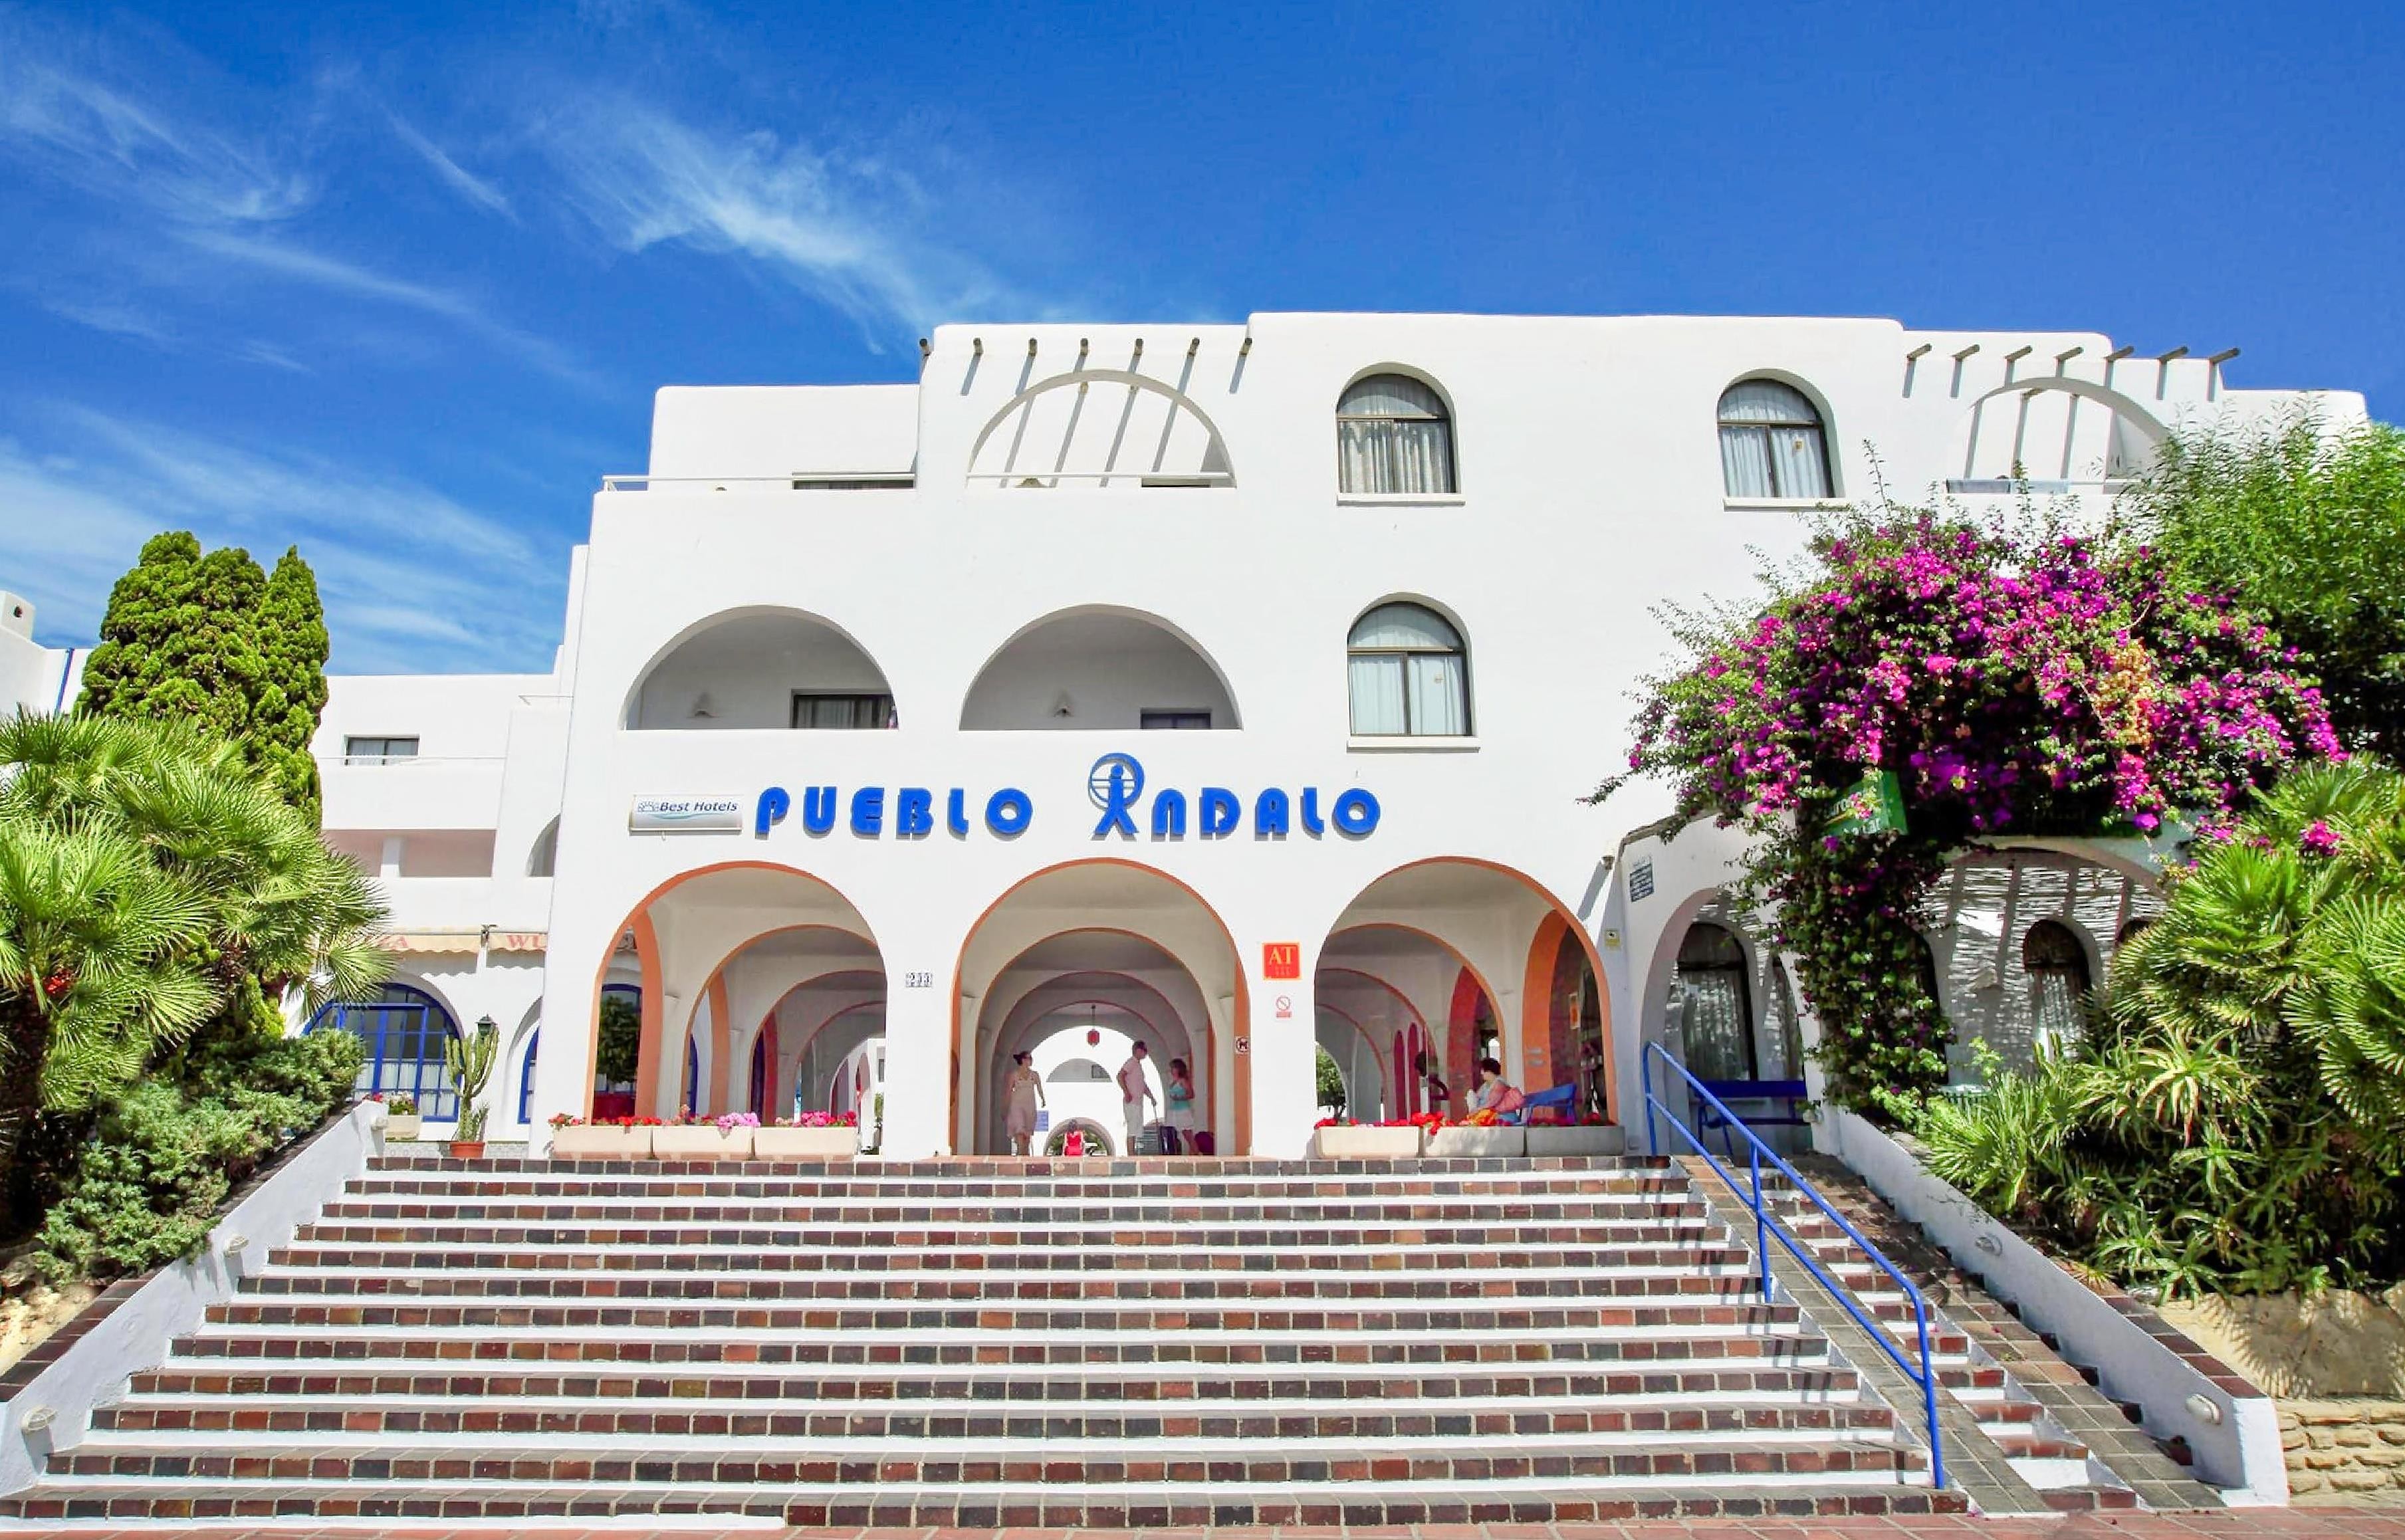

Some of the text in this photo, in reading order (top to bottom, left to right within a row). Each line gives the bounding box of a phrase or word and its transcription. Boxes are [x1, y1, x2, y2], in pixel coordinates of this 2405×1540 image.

[659, 801, 738, 812] Best Hotels
[755, 786, 1033, 834] PUEBLO
[1269, 946, 1296, 965] AT
